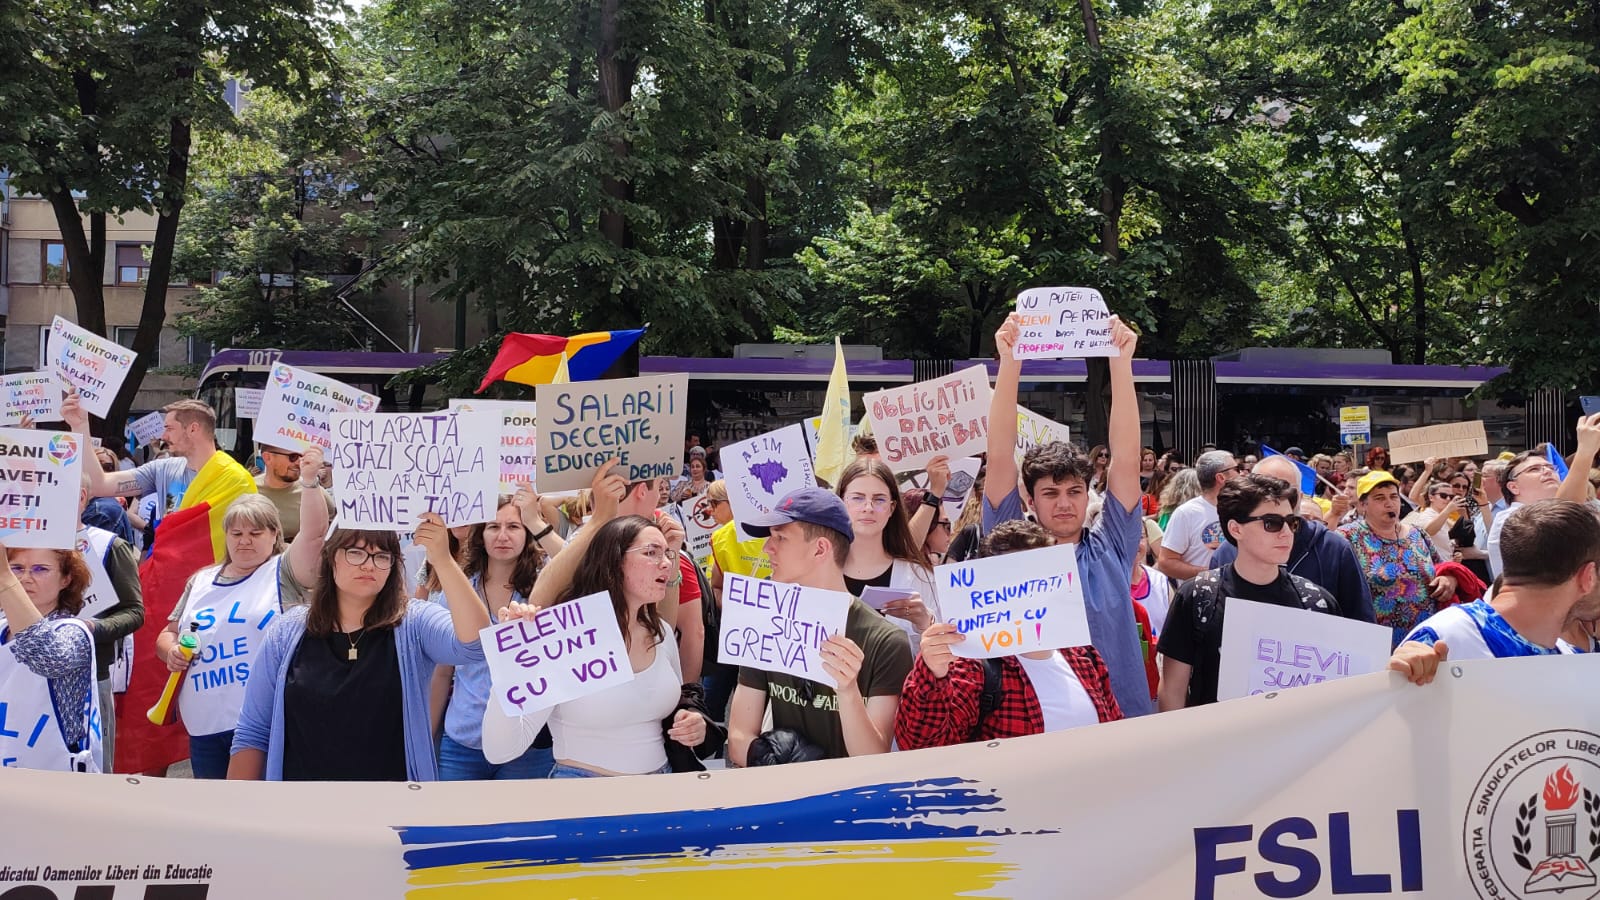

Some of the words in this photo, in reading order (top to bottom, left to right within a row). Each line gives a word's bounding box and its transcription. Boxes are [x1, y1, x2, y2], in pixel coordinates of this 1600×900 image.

[1060, 310, 1079, 325] PE
[1024, 330, 1044, 338] LOC
[62, 331, 83, 347] ANUL
[86, 342, 119, 363] VIITOR
[1074, 341, 1085, 349] PE
[55, 358, 60, 366] O
[66, 349, 76, 360] LA
[78, 355, 98, 372] VOT,
[248, 350, 284, 366] 1017
[25, 377, 50, 385] VIITOR
[78, 387, 100, 403] TOT!
[281, 393, 300, 406] NU
[304, 400, 325, 413] MAI
[296, 380, 328, 397] DACĂ
[332, 391, 354, 407] BANI
[6, 409, 32, 417] PENTRU
[287, 412, 296, 422] O
[299, 416, 315, 427] SĂ
[339, 419, 374, 442] CUM
[381, 413, 459, 446] ARATĂ
[550, 418, 660, 451] DECENTE,
[952, 415, 988, 446] BA!
[950, 567, 975, 588] NU
[1023, 606, 1047, 621] CU
[495, 602, 585, 653] ELEVII
[515, 628, 597, 668] SUNT
[1263, 666, 1326, 689] SUNT
[1477, 739, 1557, 816] SINDICATELOR
[1193, 809, 1423, 900] FSLI
[43, 864, 102, 881] Oamenilor
[105, 864, 140, 881] Liberi
[143, 864, 161, 880] din
[165, 863, 213, 883] Educație
[1533, 859, 1586, 876] FSLI
